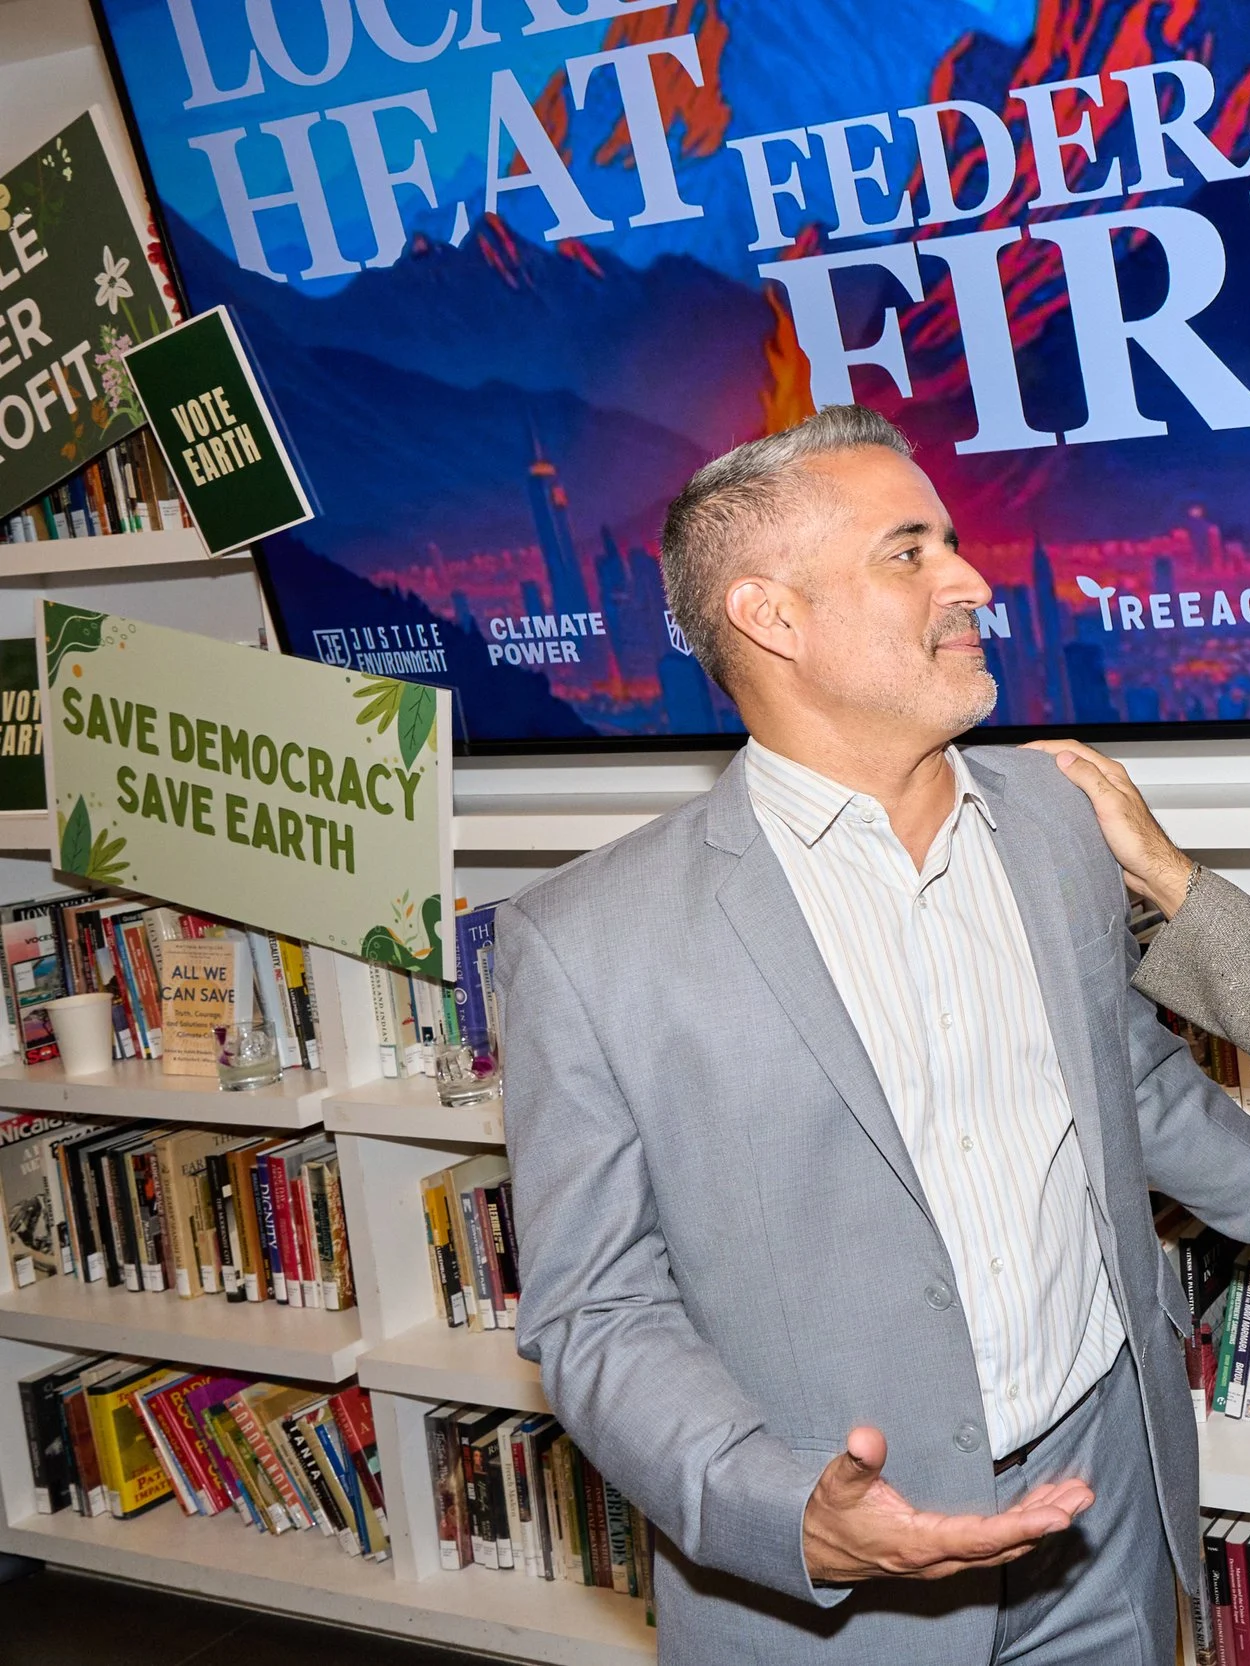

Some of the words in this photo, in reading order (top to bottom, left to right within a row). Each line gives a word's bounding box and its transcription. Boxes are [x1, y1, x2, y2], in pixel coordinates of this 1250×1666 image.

[188, 33, 705, 283] HEAT
[0, 340, 98, 452] OFIT
[171, 386, 236, 444] VOTE
[181, 423, 262, 487] EARTH
[350, 623, 443, 651] JUSTICE
[490, 612, 606, 640] CLIMATE
[356, 649, 448, 675] ENVIRONMENT
[488, 640, 581, 666] POWER
[2, 689, 41, 722] VOT
[0, 723, 44, 756] ART
[62, 687, 160, 756] SAVE
[169, 711, 421, 821] DEMOCRACY
[116, 765, 215, 836] SAVE
[226, 802, 356, 874] EARTH
[171, 965, 199, 980] ALL
[203, 966, 226, 981] WE
[161, 986, 195, 1001] CAN
[200, 988, 235, 1003] SAVE
[260, 1183, 278, 1250] DIGNITY
[487, 1203, 502, 1236] FLEXIBLE
[1238, 1320, 1250, 1352] MARMARA
[289, 1425, 323, 1481] TANIA
